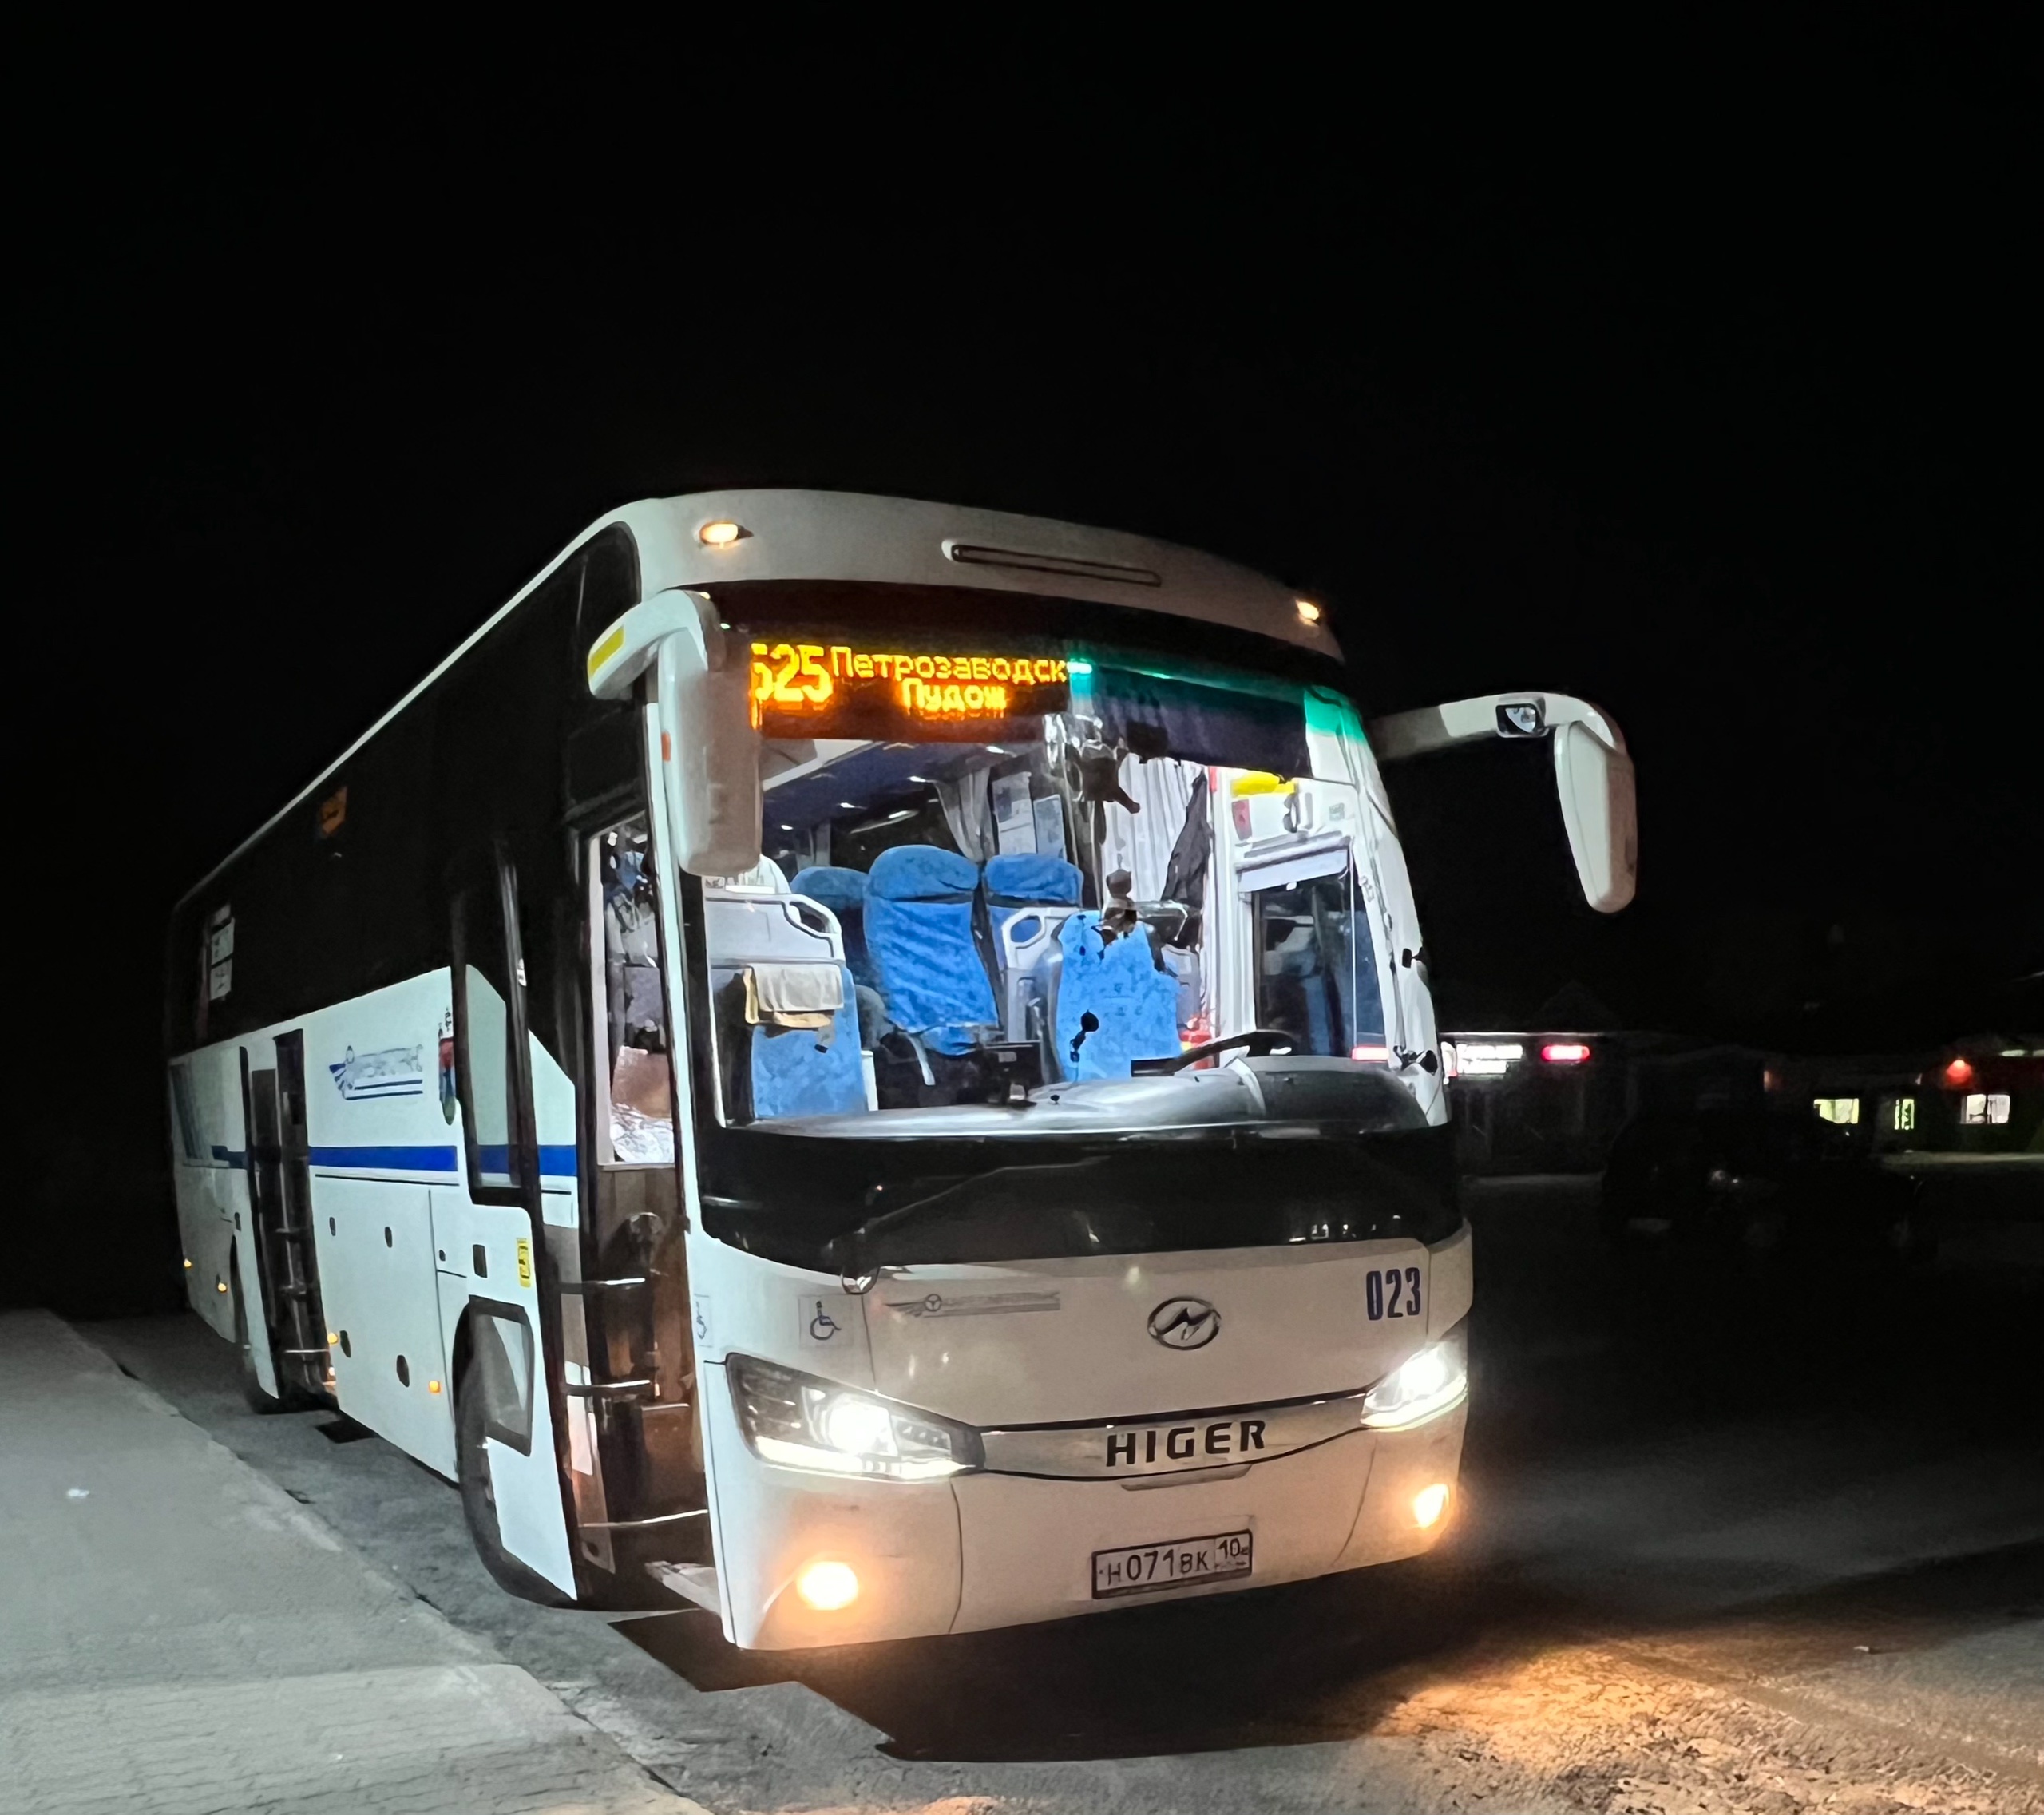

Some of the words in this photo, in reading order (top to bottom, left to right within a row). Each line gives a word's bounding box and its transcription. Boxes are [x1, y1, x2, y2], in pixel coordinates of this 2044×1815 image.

[830, 646, 1067, 684] Петрозаводск
[1365, 1266, 1421, 1321] 023
[1106, 1420, 1266, 1467] HIGER
